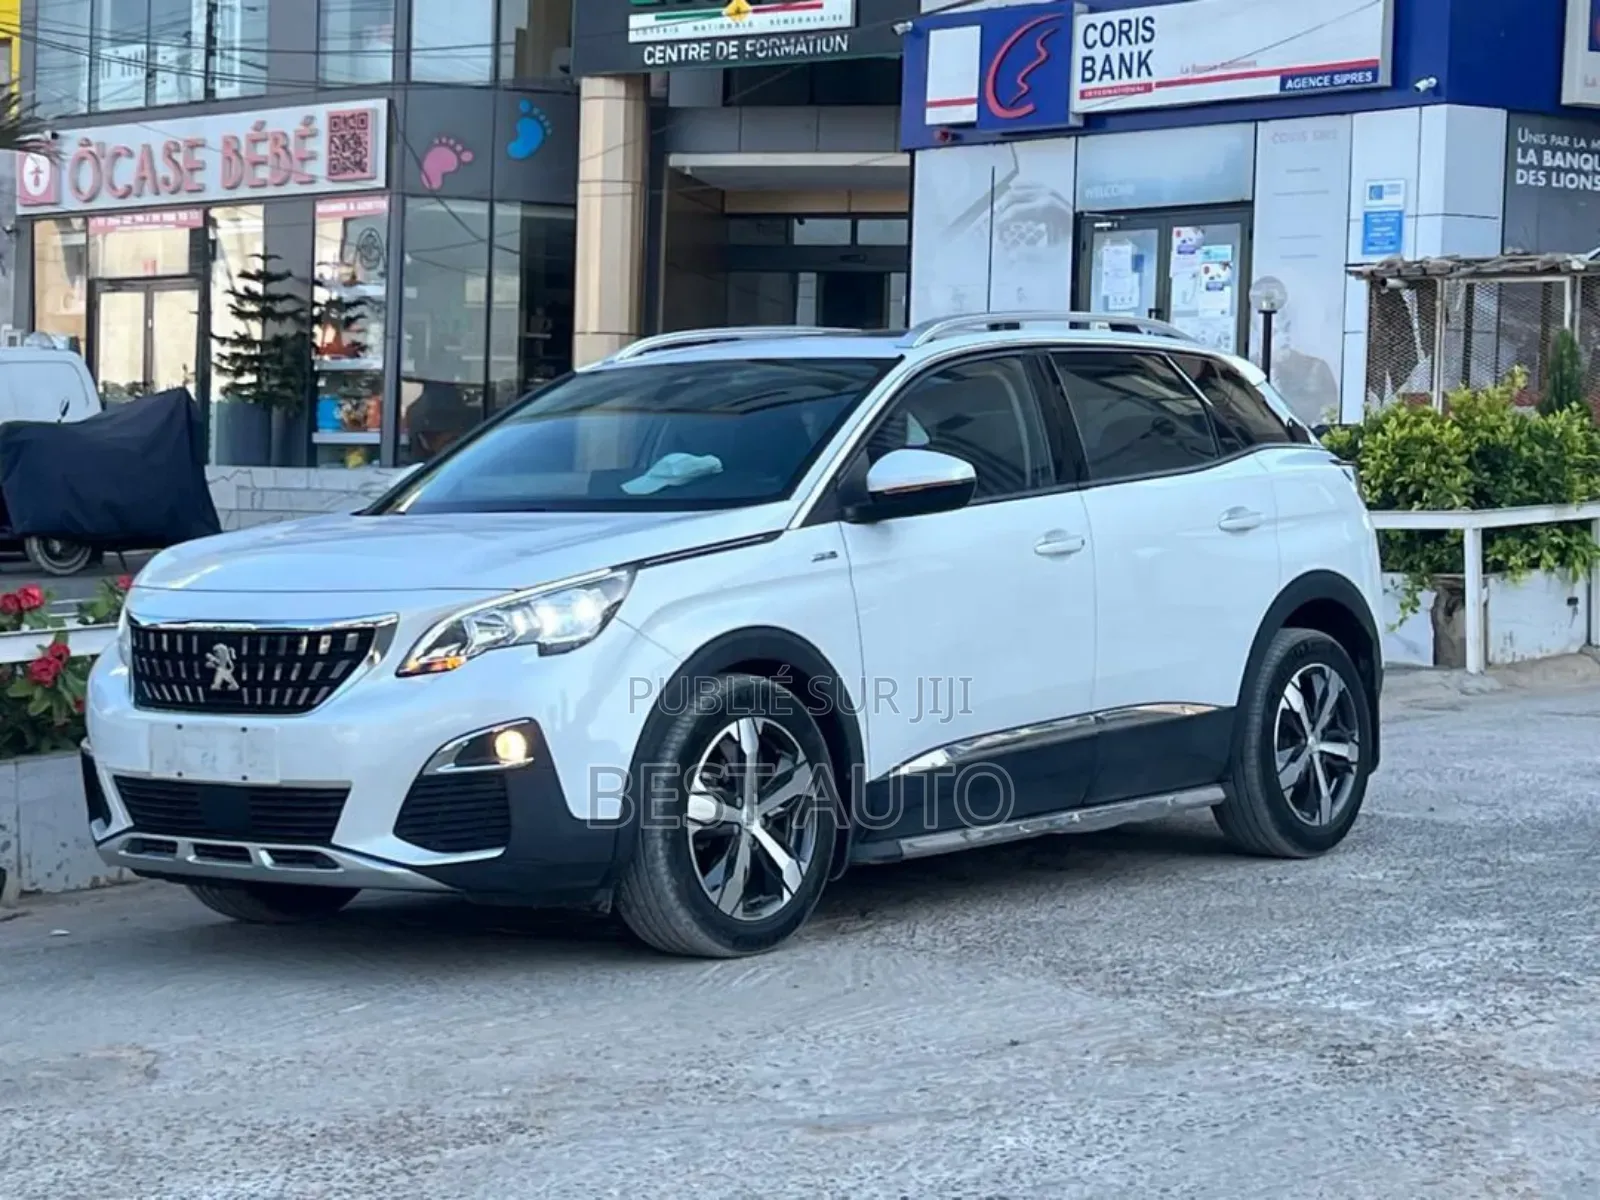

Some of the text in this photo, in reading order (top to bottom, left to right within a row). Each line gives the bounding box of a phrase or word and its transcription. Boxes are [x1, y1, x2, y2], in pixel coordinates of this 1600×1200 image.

[1083, 16, 1156, 49] CORIS
[643, 34, 848, 65] CENTRE DE FORMATION
[1081, 50, 1153, 83] BANK
[1285, 71, 1373, 90] AGENCE SIPRES
[220, 116, 319, 190] BÉBÉ
[1517, 147, 1538, 166] LA
[1516, 169, 1600, 192] DES LIONS
